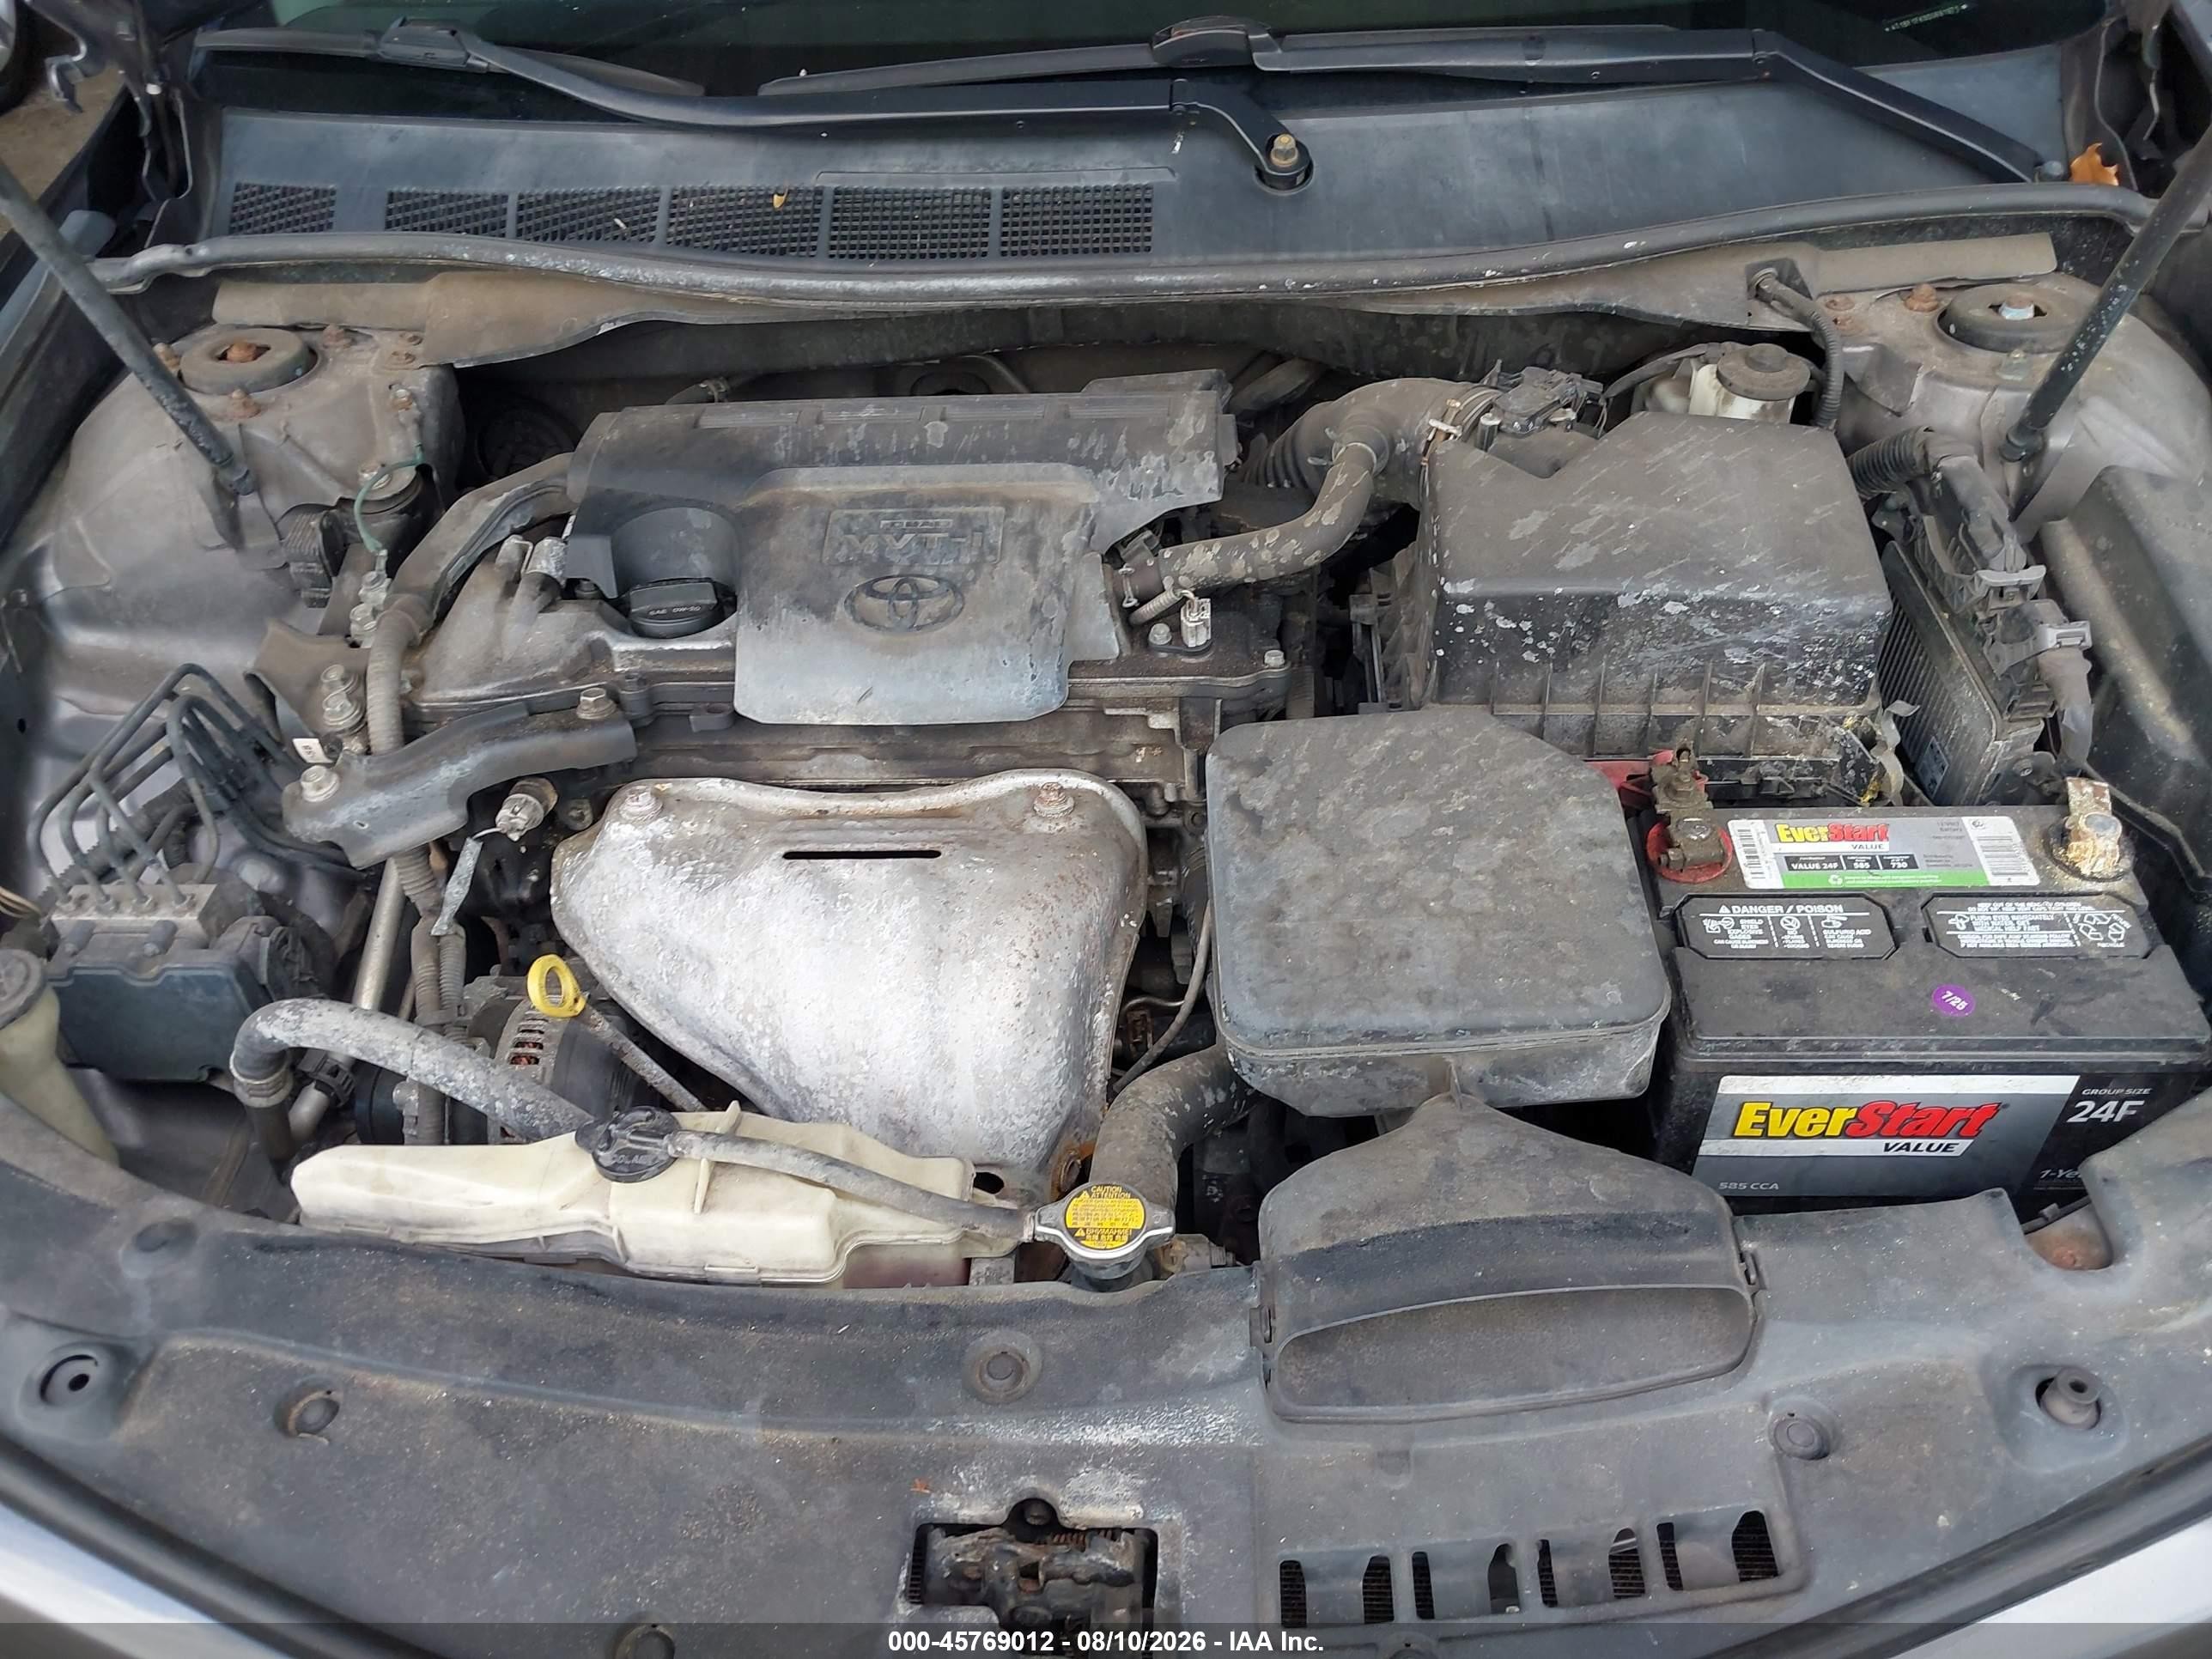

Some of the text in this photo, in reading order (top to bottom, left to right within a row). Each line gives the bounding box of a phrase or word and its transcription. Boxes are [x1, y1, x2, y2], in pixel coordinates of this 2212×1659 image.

[1775, 823, 1890, 842] EverStart
[1731, 904, 1844, 914] DANGER / POISON
[2066, 1100, 2145, 1123] 24F
[1733, 1101, 2002, 1139] EverStart
[1884, 1142, 1960, 1153] VALUE
[1091, 1185, 1122, 1194] CAUTION
